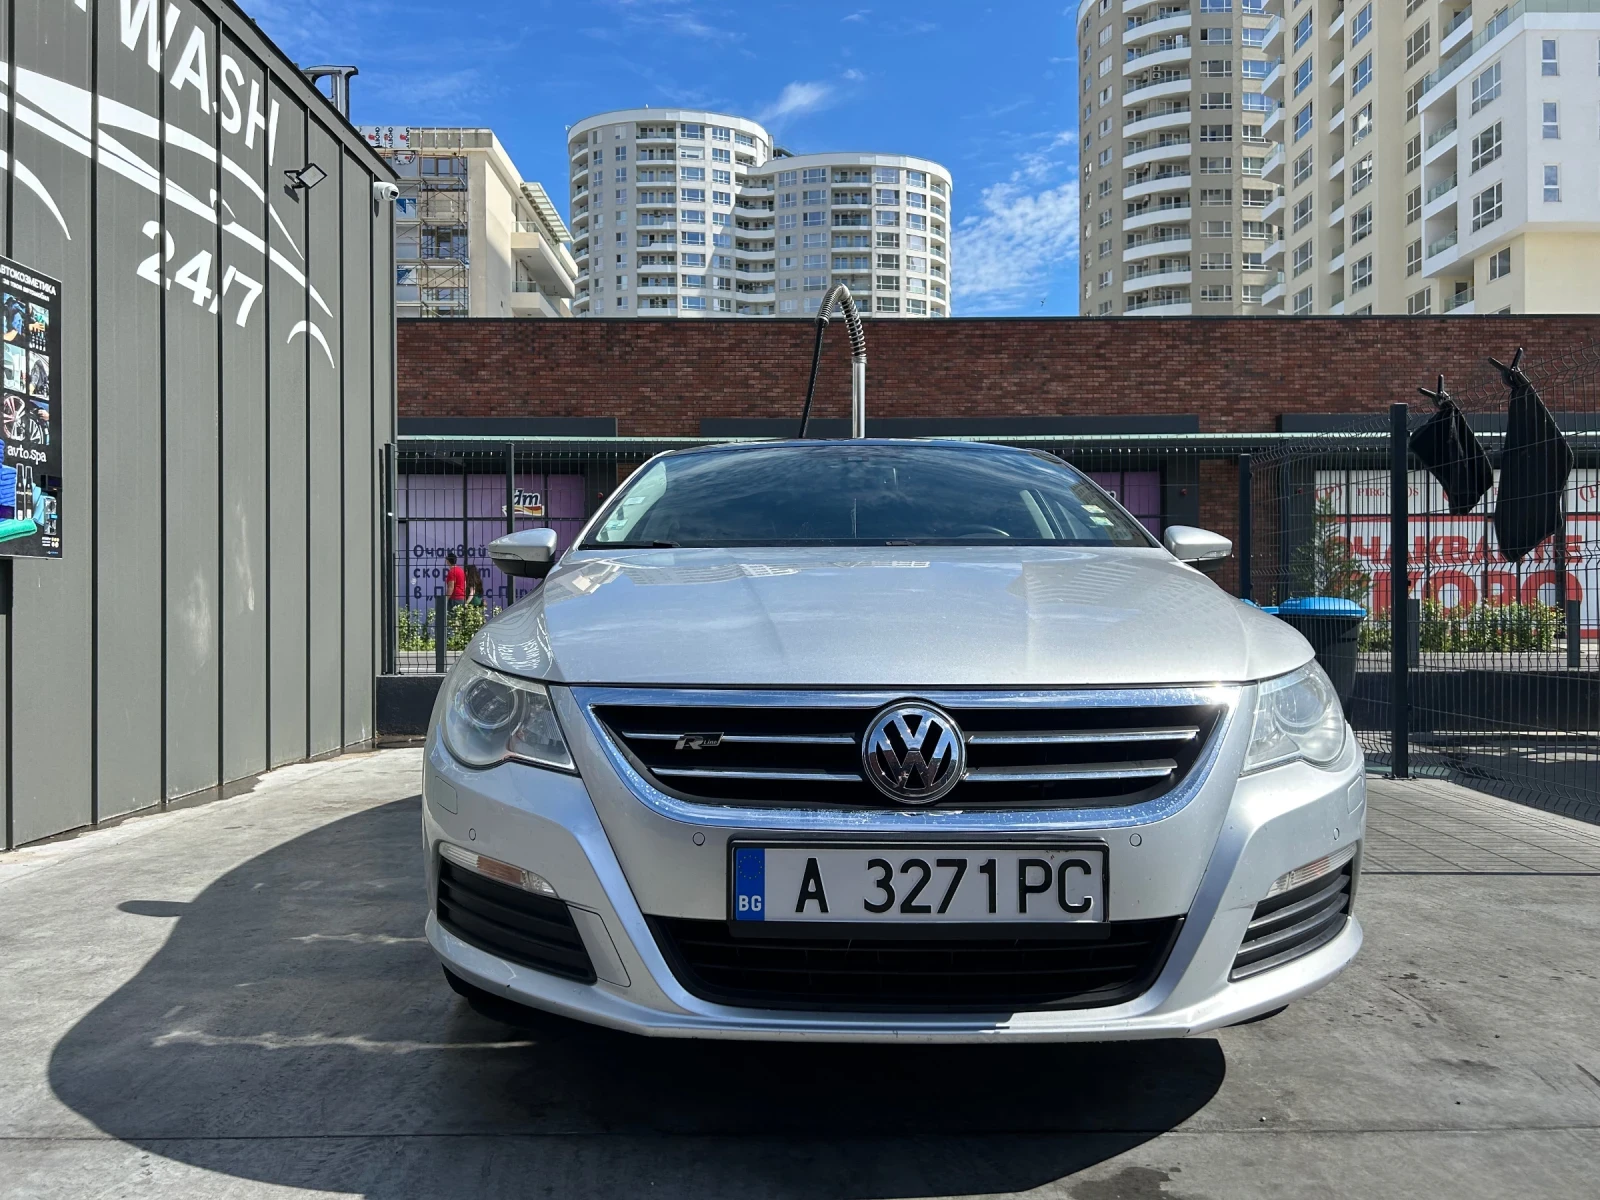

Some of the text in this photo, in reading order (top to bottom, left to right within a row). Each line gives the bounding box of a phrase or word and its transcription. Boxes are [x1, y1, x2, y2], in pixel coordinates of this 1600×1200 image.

[119, 0, 280, 167] WASH
[136, 220, 263, 328] 24/7
[738, 894, 762, 912] BG
[795, 857, 1094, 914] A 3271 PC
